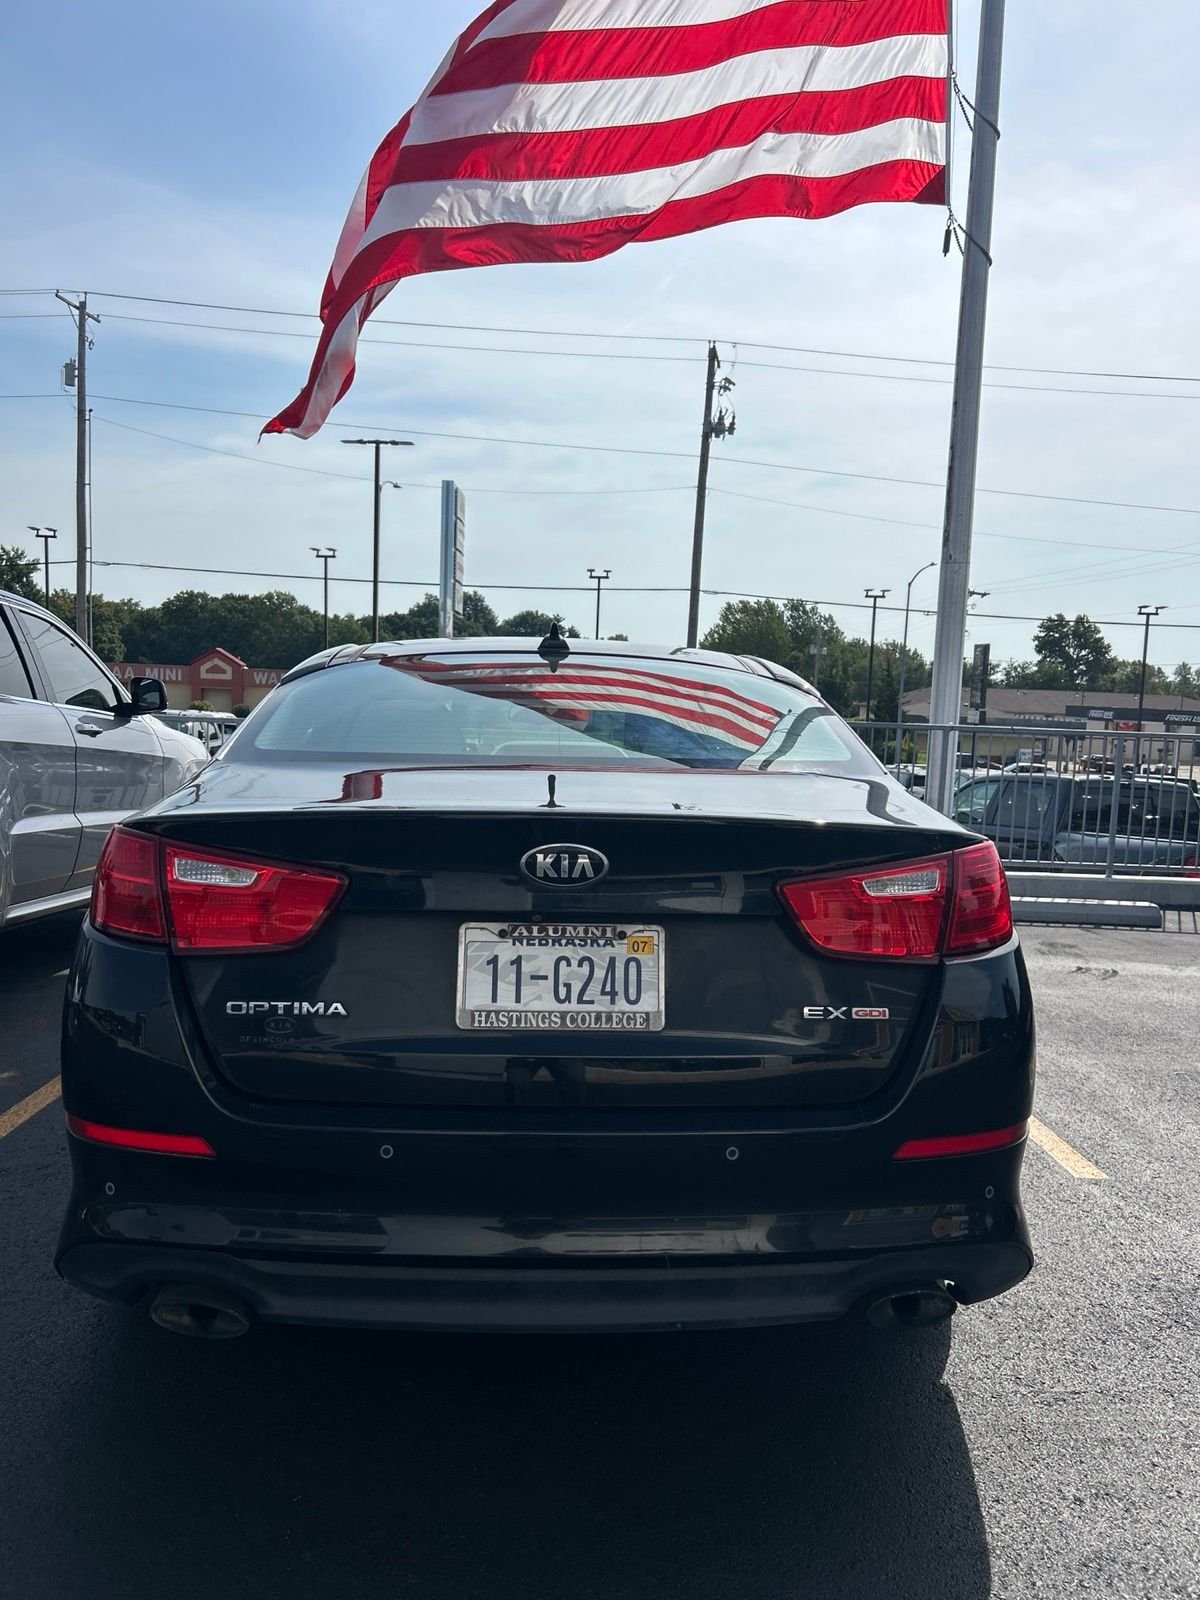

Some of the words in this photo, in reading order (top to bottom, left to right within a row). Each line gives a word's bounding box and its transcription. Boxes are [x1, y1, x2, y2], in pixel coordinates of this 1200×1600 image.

[145, 667, 182, 681] MINI
[1165, 714, 1193, 722] FINISH
[536, 853, 595, 878] KIA
[512, 925, 614, 938] ALUMNI
[631, 940, 649, 953] 07
[486, 954, 642, 1006] 11-G240
[226, 1001, 348, 1016] OPTIMA
[803, 1006, 849, 1020] EX
[853, 1009, 887, 1018] GDI
[473, 1011, 561, 1028] HASTINGS
[566, 1012, 647, 1029] COLLEGE
